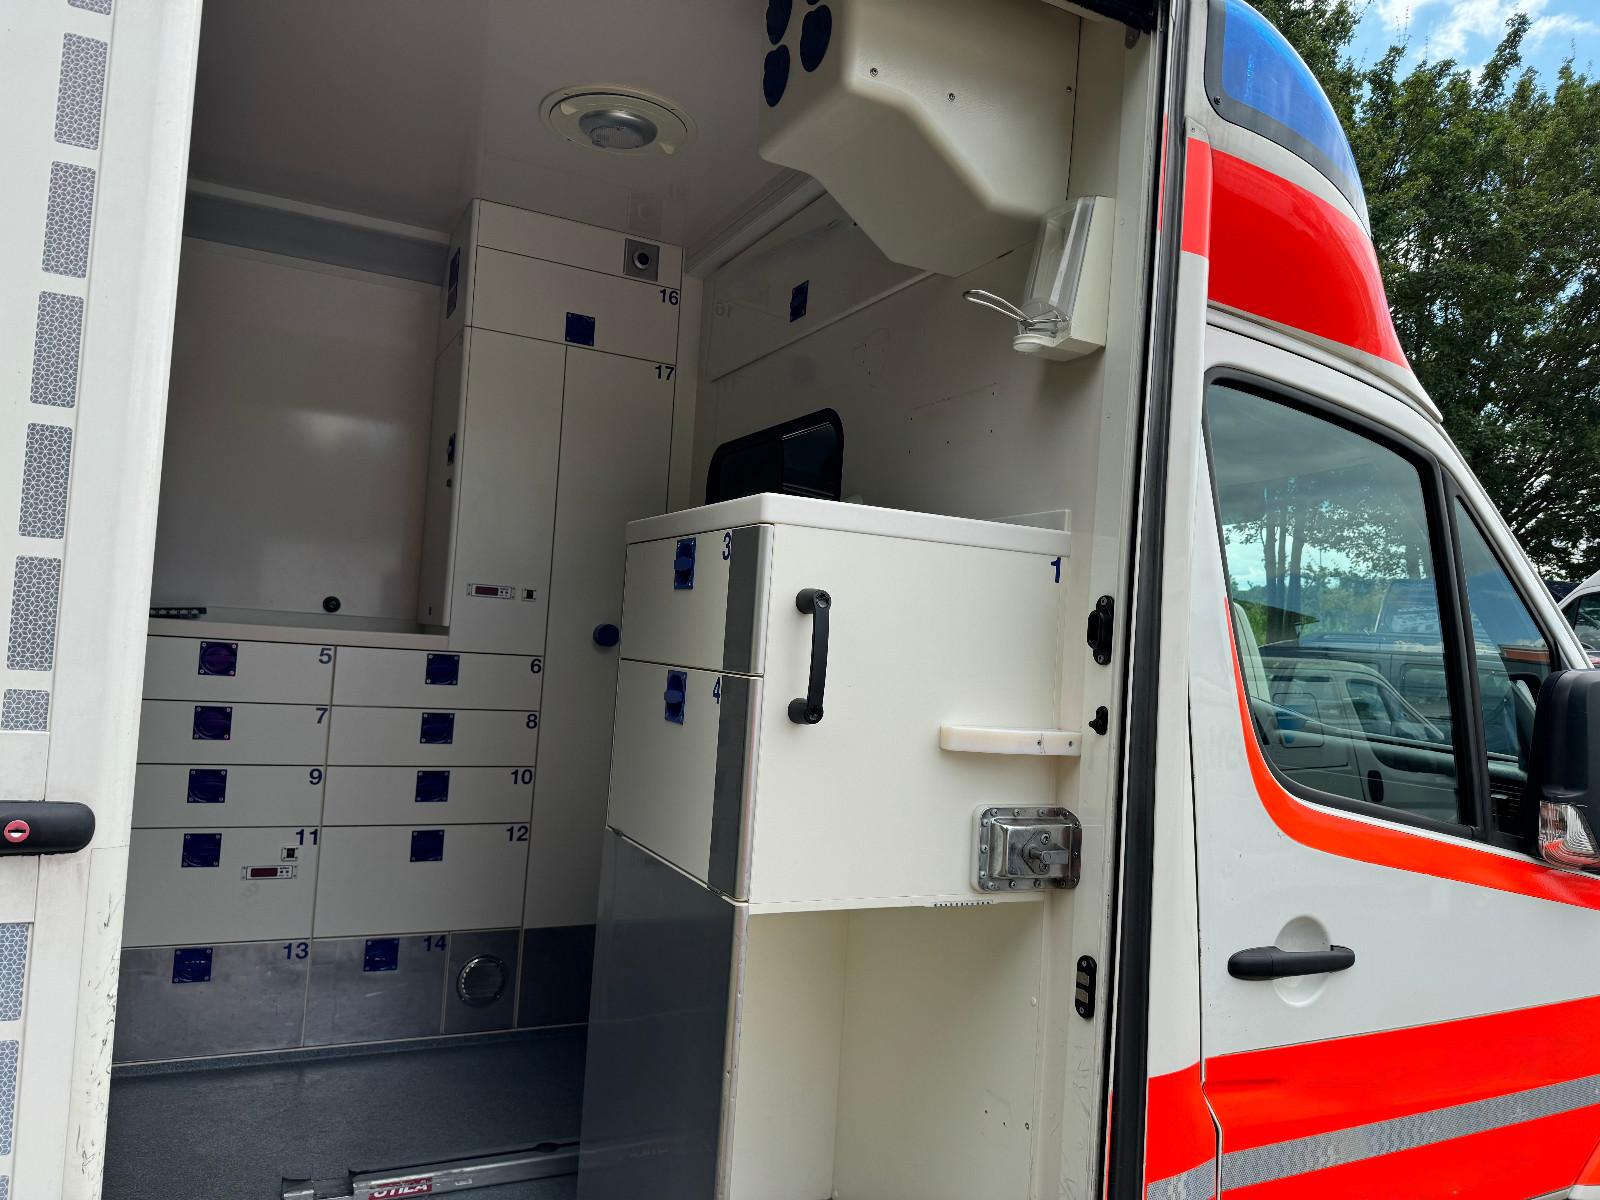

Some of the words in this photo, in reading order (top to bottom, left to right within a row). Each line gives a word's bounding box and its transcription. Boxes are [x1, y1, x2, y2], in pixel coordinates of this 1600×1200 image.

[659, 289, 679, 306] 16
[655, 364, 675, 381] 17
[722, 531, 732, 560] 3
[1050, 556, 1061, 584] 1
[319, 648, 332, 665] 5
[530, 658, 542, 674] 6
[712, 676, 721, 705] 4
[315, 707, 329, 724] 7
[526, 713, 538, 730] 8
[309, 768, 323, 786] 9
[511, 768, 533, 785] 10
[295, 828, 319, 846] 11
[506, 825, 529, 842] 12
[283, 942, 309, 960] 13
[423, 934, 447, 952] 14
